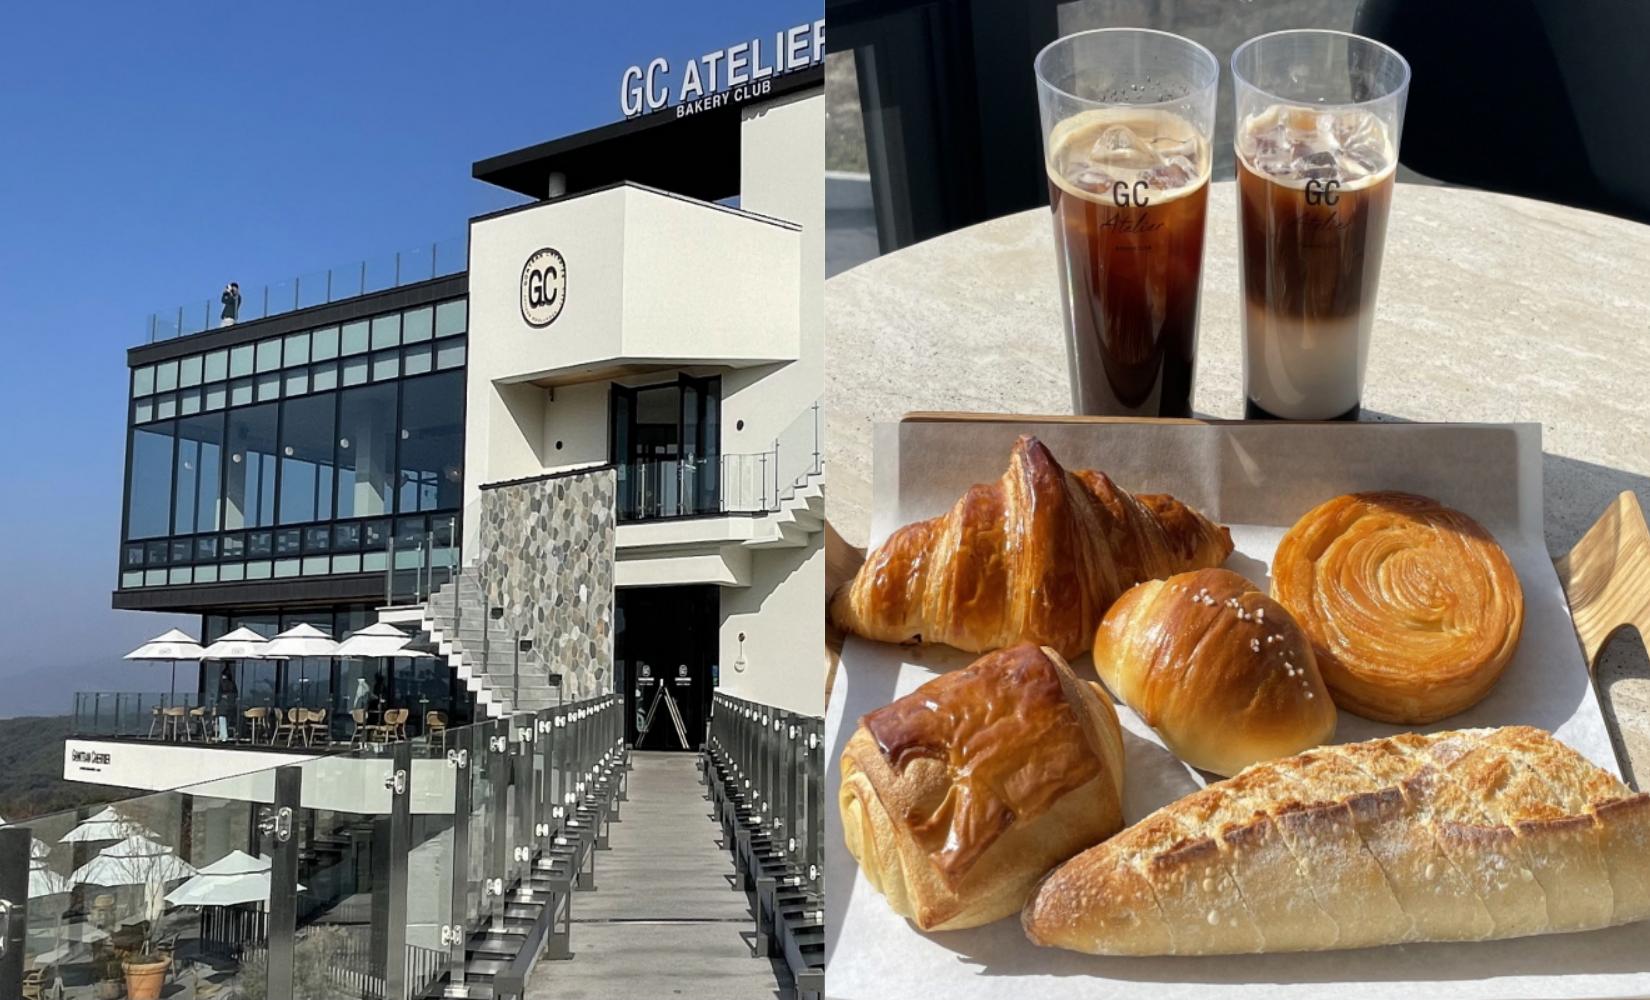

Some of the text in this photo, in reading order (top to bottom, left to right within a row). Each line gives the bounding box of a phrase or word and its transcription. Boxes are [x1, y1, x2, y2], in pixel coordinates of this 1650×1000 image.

[621, 57, 671, 117] GC
[676, 80, 771, 118] BAKERY CLUB
[1113, 180, 1150, 208] GC
[1305, 179, 1341, 206] GC
